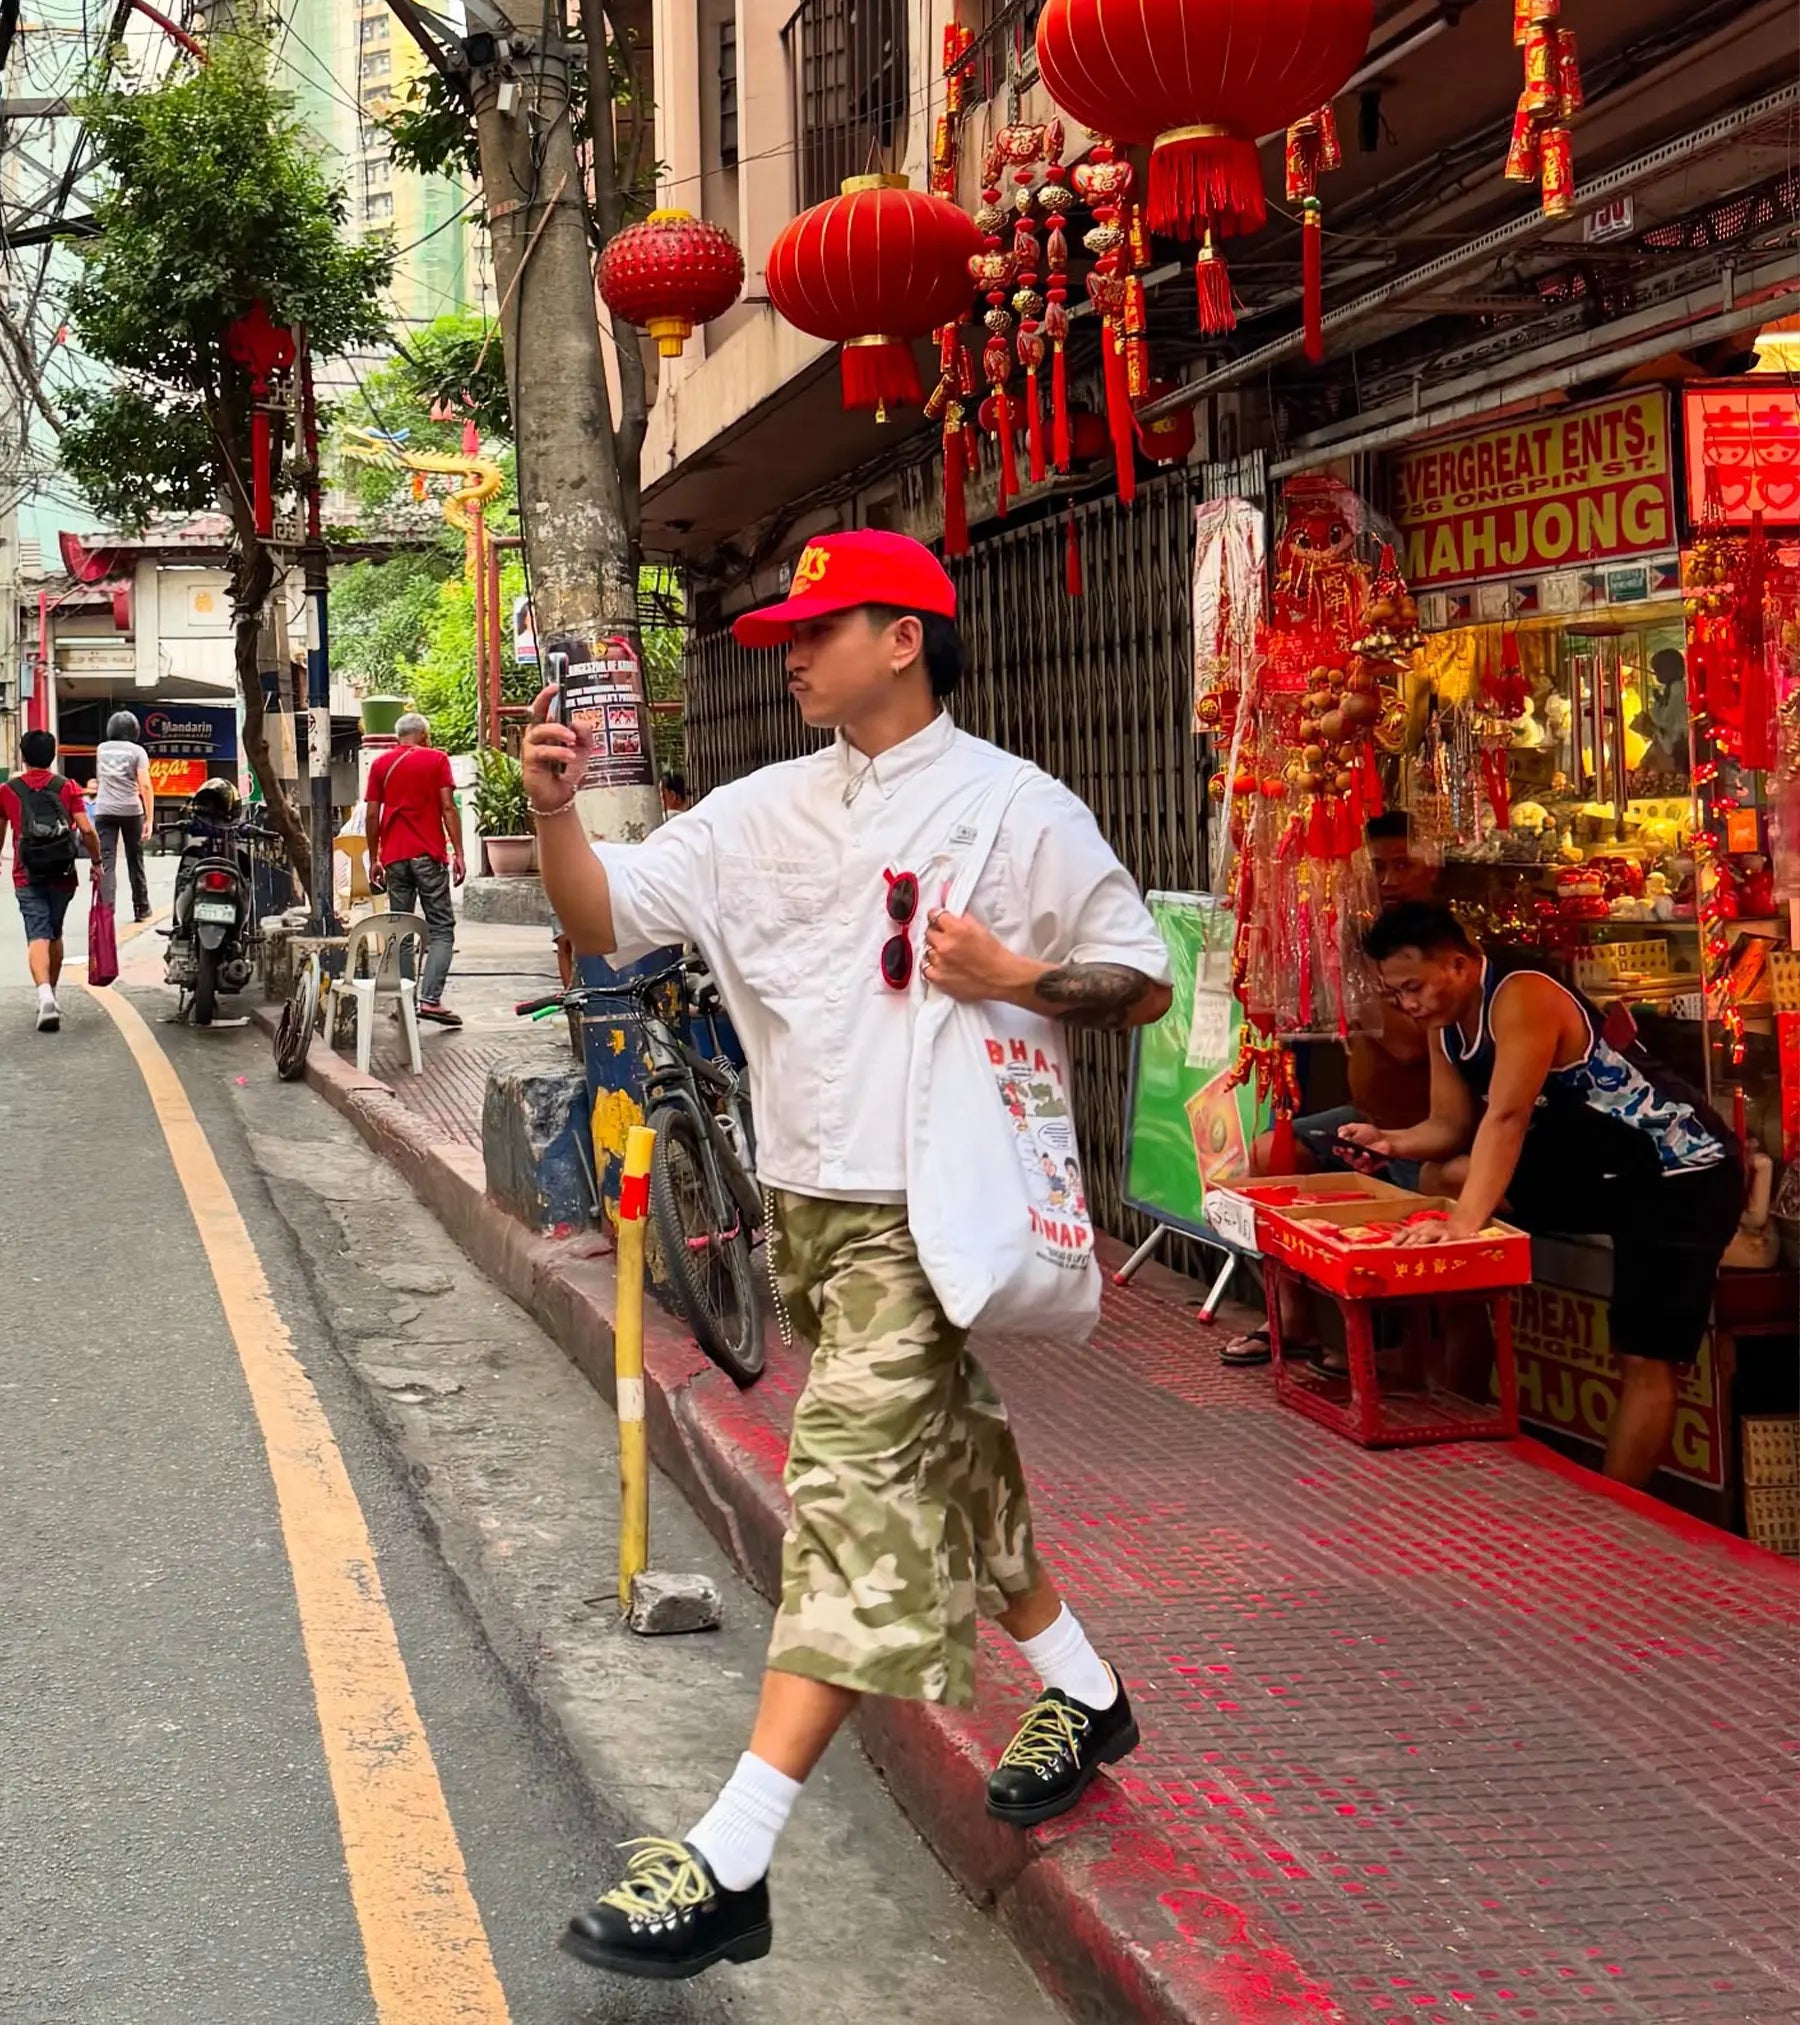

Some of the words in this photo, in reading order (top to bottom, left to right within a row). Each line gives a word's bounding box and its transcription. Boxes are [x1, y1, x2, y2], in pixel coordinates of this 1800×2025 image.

[1454, 468, 1588, 507] ONGPIN
[1602, 456, 1657, 477] ST.
[1404, 484, 1667, 579] MAHJONG
[162, 721, 212, 735] Mandarin
